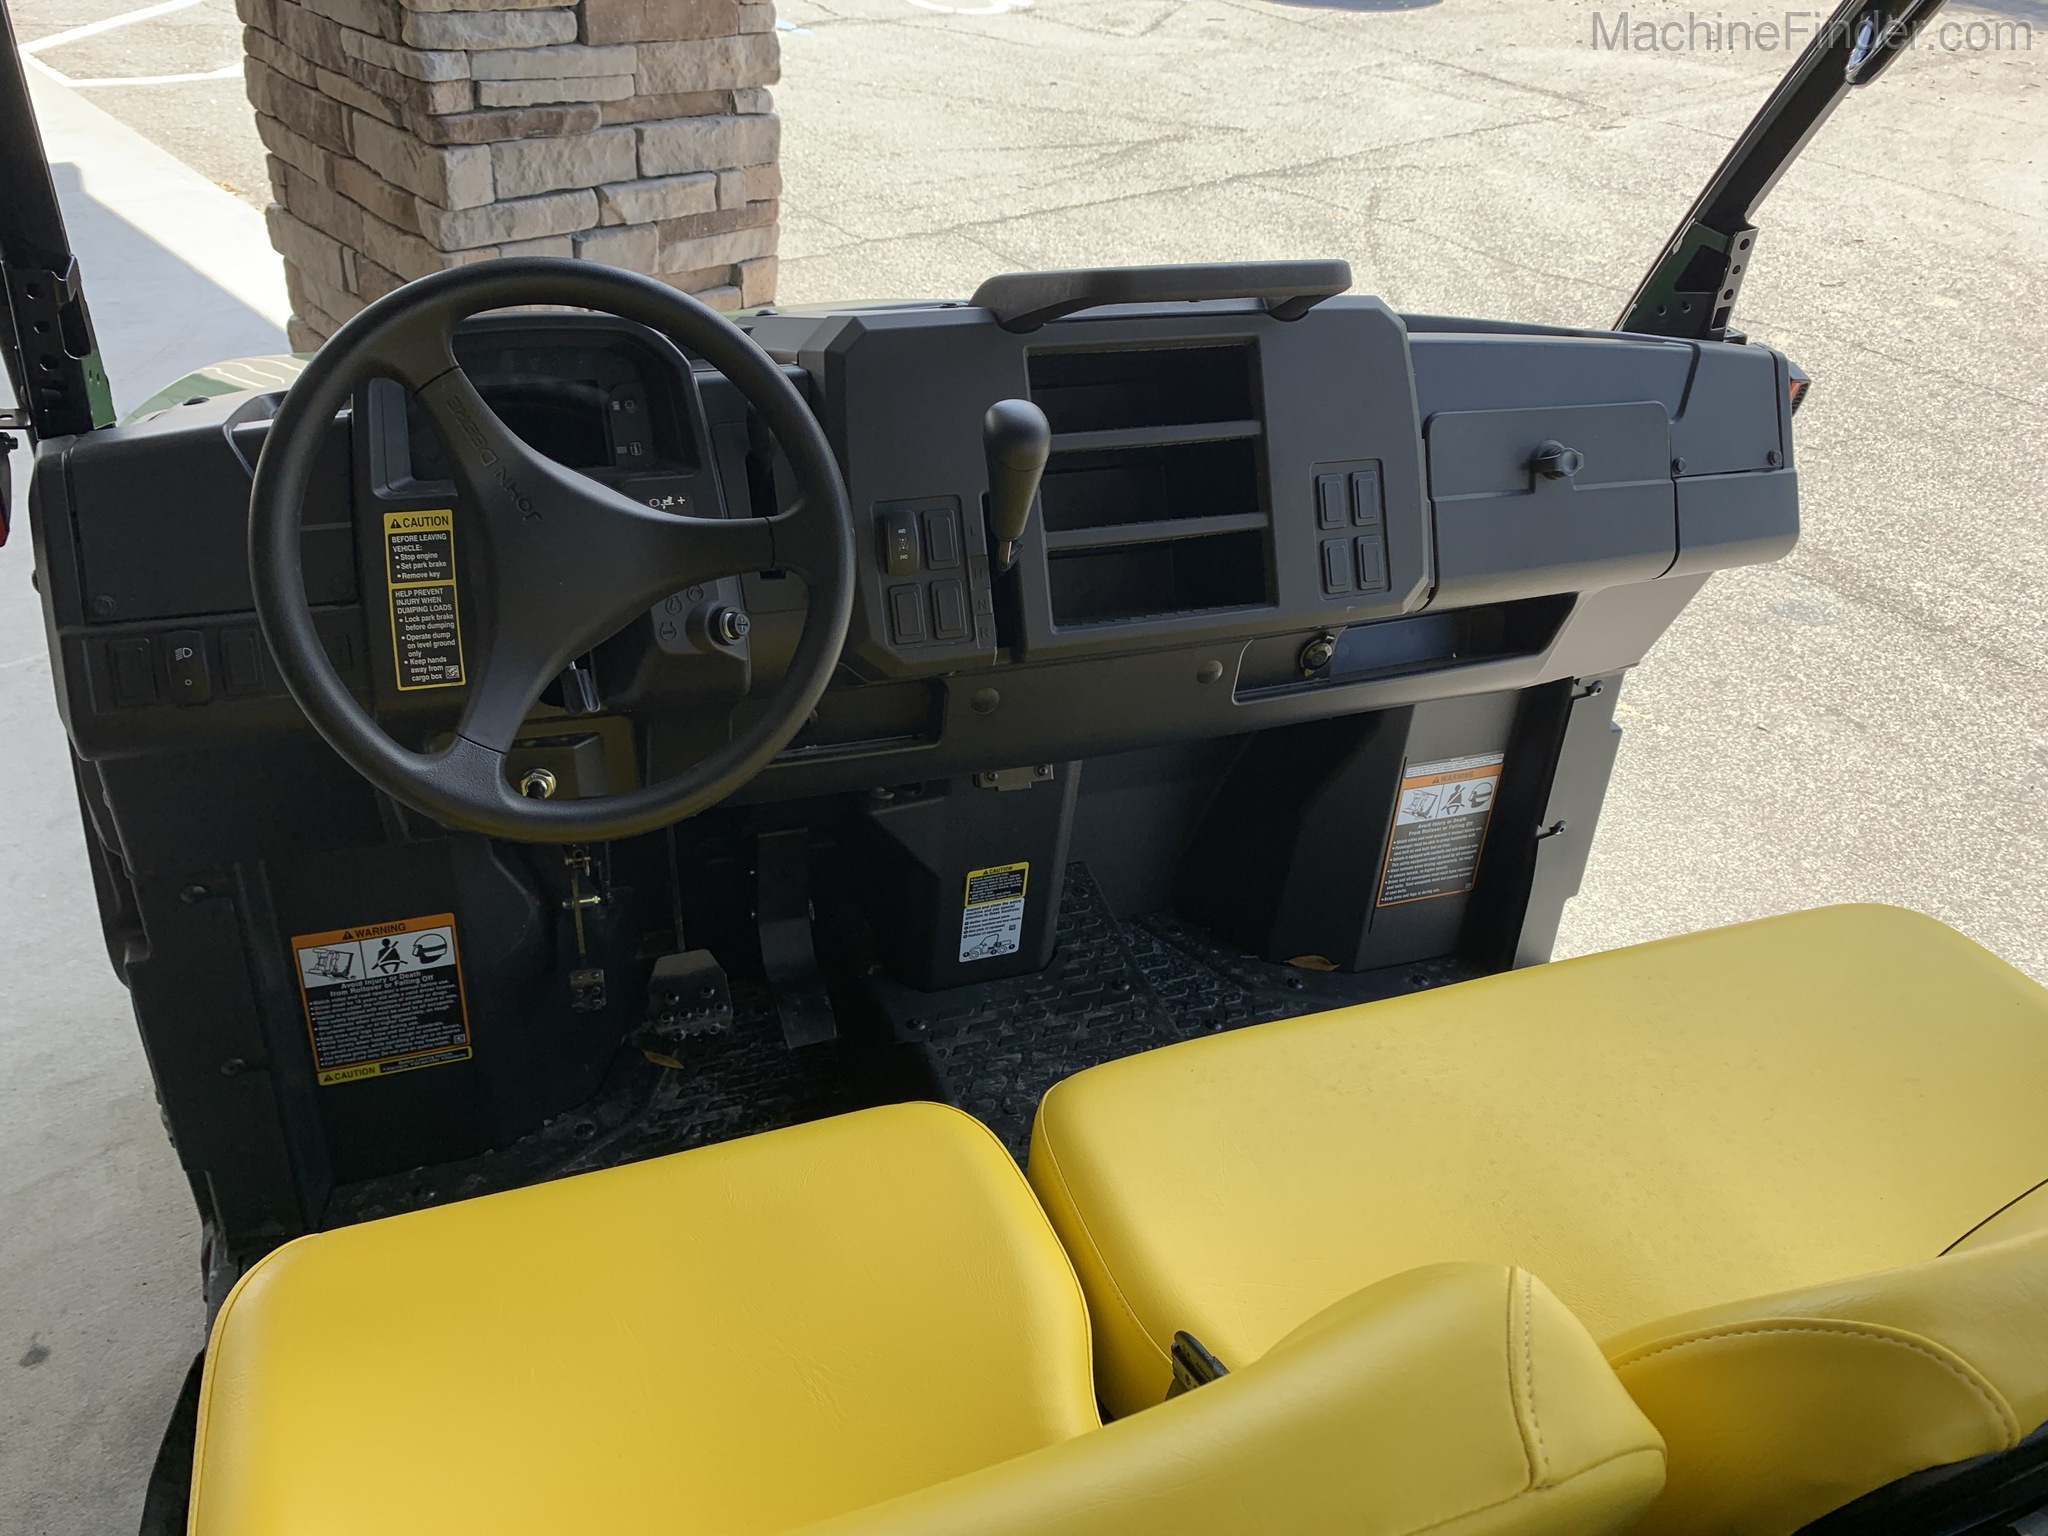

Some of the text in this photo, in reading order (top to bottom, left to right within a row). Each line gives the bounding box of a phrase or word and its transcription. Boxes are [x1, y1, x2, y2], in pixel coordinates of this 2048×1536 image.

[447, 395, 543, 522] JOHN DEERE
[403, 516, 449, 528] CAUTION
[392, 533, 446, 543] BEFORE LEAVING
[413, 562, 427, 570] park
[414, 588, 443, 596] PREVENT
[398, 606, 428, 614] DUMPING
[433, 640, 455, 648] ground
[1440, 770, 1475, 782] WARNING
[989, 866, 1013, 874] CAUTION
[354, 923, 406, 938] WARNING
[340, 980, 362, 989] Avoid
[364, 976, 387, 985] Injury
[399, 971, 421, 979] Death
[334, 1066, 375, 1080] CAUTION
